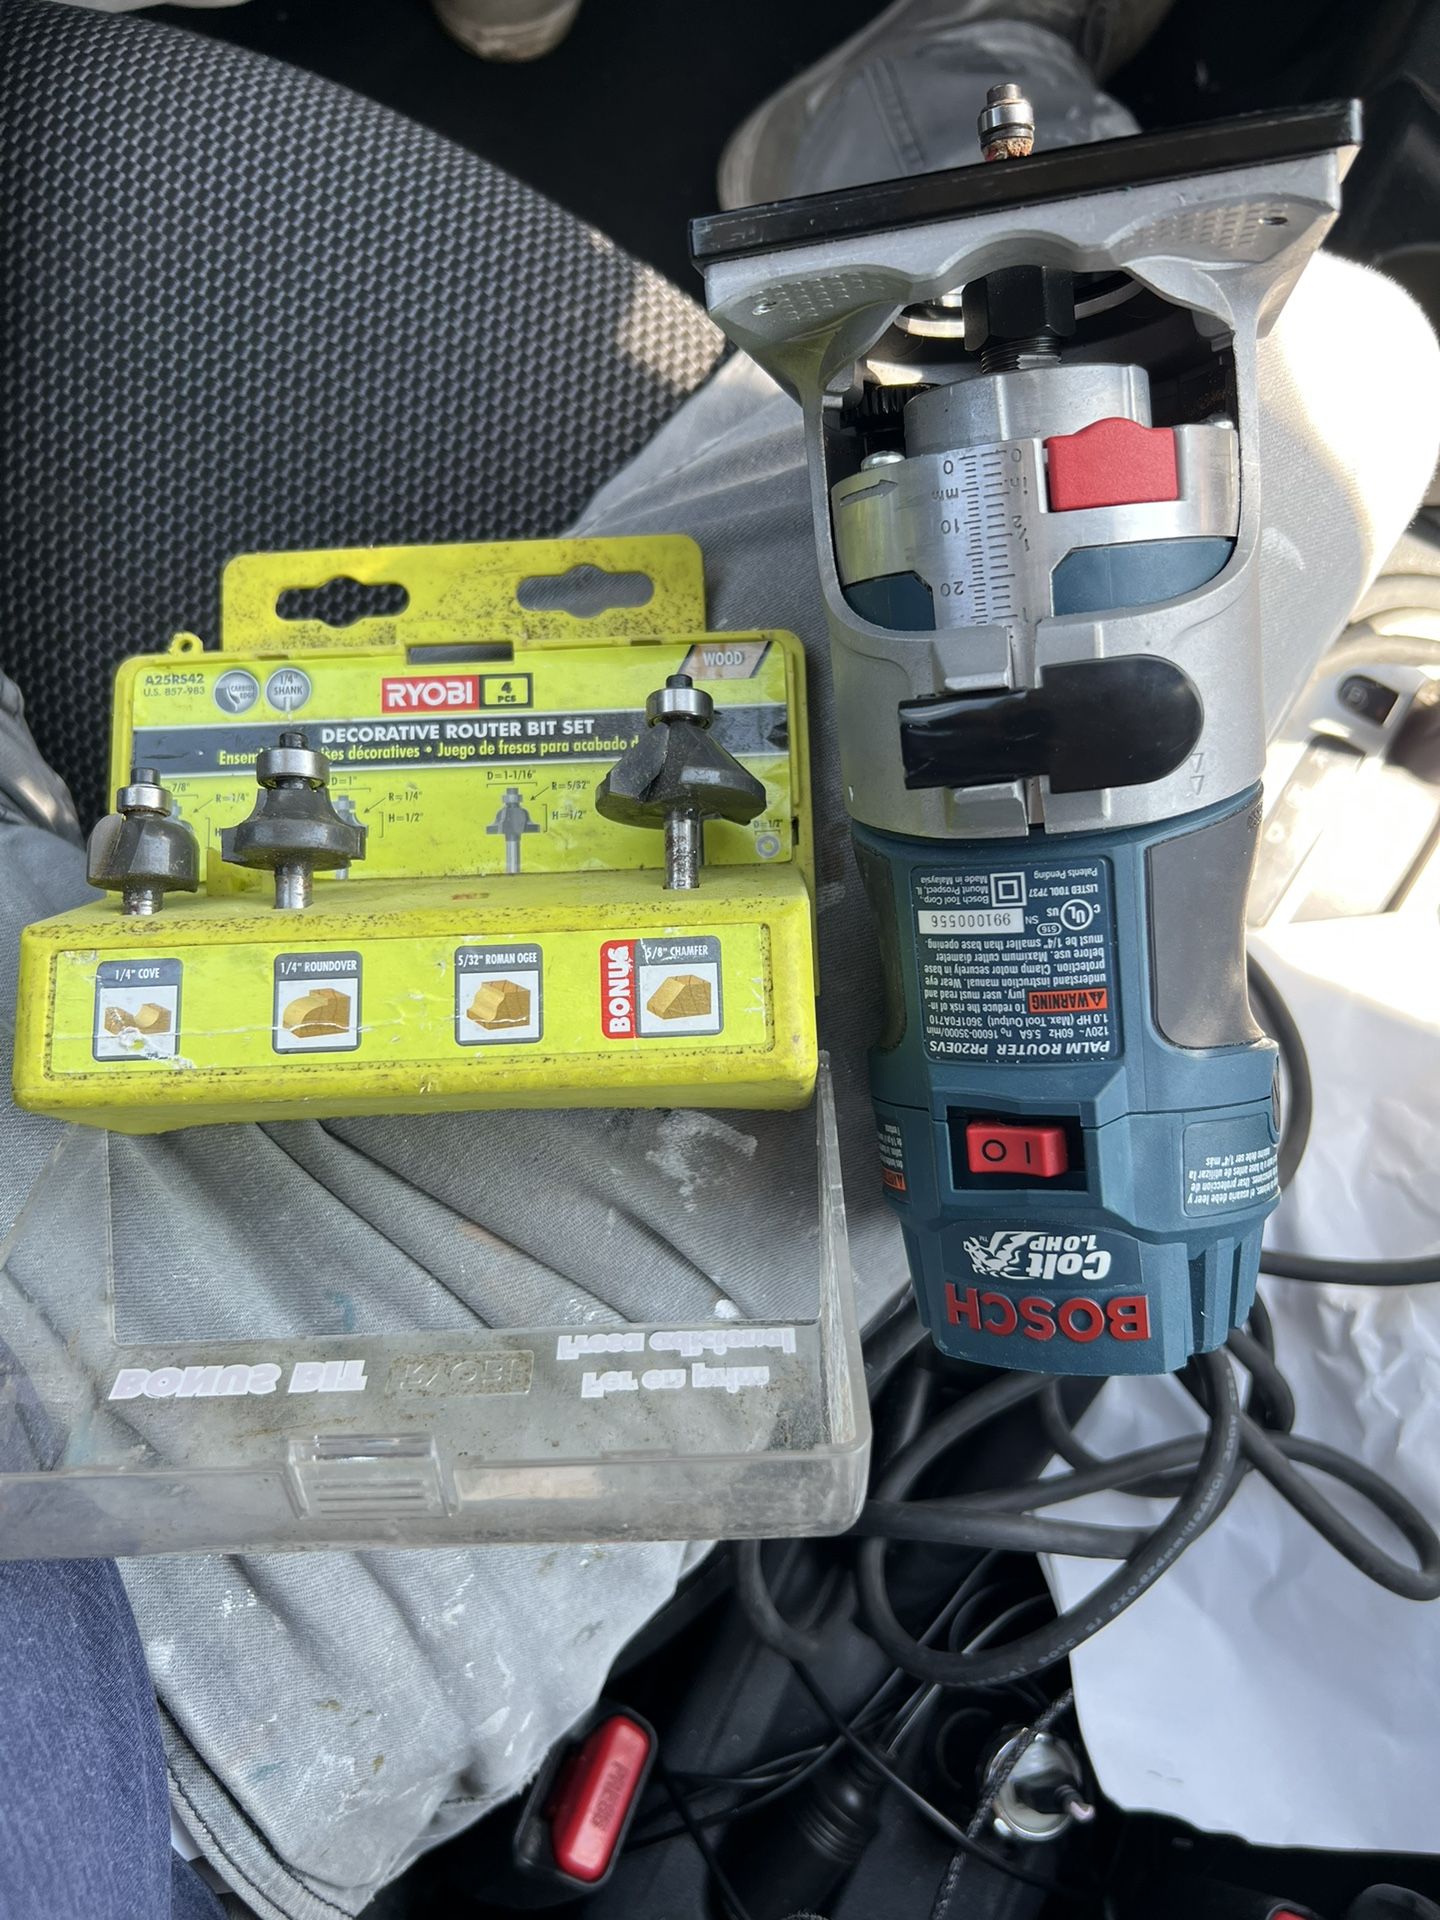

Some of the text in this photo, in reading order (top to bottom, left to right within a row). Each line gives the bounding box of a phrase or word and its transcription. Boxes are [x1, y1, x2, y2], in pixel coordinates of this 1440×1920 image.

[941, 518, 960, 534] 10
[941, 580, 964, 597] 20
[703, 651, 743, 666] WOOD
[145, 672, 205, 686] A25RS42
[143, 685, 206, 698] U.S. 857-983
[273, 686, 303, 697] SHANK
[501, 681, 513, 694] 4
[385, 682, 475, 708] RYOBI
[497, 695, 517, 703] PCS
[321, 719, 595, 744] DECORATIVE ROUTER BIT SET
[348, 743, 421, 761] décoratives
[438, 741, 476, 760] Juego
[480, 739, 495, 757] de
[499, 738, 537, 756] fresas
[540, 739, 569, 756] para
[573, 736, 628, 752] acabado
[921, 875, 988, 885] Made in Malaysia
[1034, 867, 1098, 880] Patents Pending
[916, 885, 988, 896] Mount Prospect, IL
[1029, 884, 1098, 898] LISTED TOOL 7P37
[944, 896, 961, 905] Tool
[962, 895, 989, 905] Bosch
[1046, 907, 1060, 917] US
[1068, 906, 1086, 923] UL
[930, 912, 1011, 927] 991000556
[1025, 915, 1039, 925] SN
[925, 934, 1104, 951] must be 1/4" smaller than base opening.
[670, 945, 709, 957] CHAMFER
[936, 947, 1105, 963] before use. Maximum cutter diameter
[458, 952, 538, 968] 5/32" ROMAN OGEE
[281, 960, 358, 975] 1/4" ROUNDOVER
[924, 959, 1105, 976] protection. Clamp motor securely in base
[115, 967, 161, 982] 1/4" COVE
[925, 974, 1106, 988] understand instruction manual. Wear eye
[607, 945, 632, 1033] BONUS
[924, 989, 939, 1000] and
[940, 990, 957, 1001] read
[960, 991, 980, 1002] must
[982, 992, 1002, 1001] user
[1031, 993, 1089, 1011] WARNING
[928, 1002, 1027, 1014] To reduce the risk of in-
[987, 1015, 1024, 1029] Output)
[1025, 1017, 1047, 1028] Tool
[1047, 1014, 1075, 1026] (Max.
[1076, 1015, 1091, 1026] HP
[1094, 1013, 1109, 1024] 1.0
[926, 1025, 998, 1040] 16000-35000/min
[1019, 1029, 1041, 1040] 5.6A
[1048, 1028, 1074, 1038] 60Hz
[929, 1040, 1110, 1056] PALM ROUTER PR20EVS
[1189, 1170, 1197, 1181] la
[1190, 1182, 1201, 1193] de
[1194, 1194, 1209, 1205] leer
[1210, 1193, 1227, 1204] debe
[1026, 1250, 1111, 1281] Colt
[944, 1283, 1152, 1344] BOSCH
